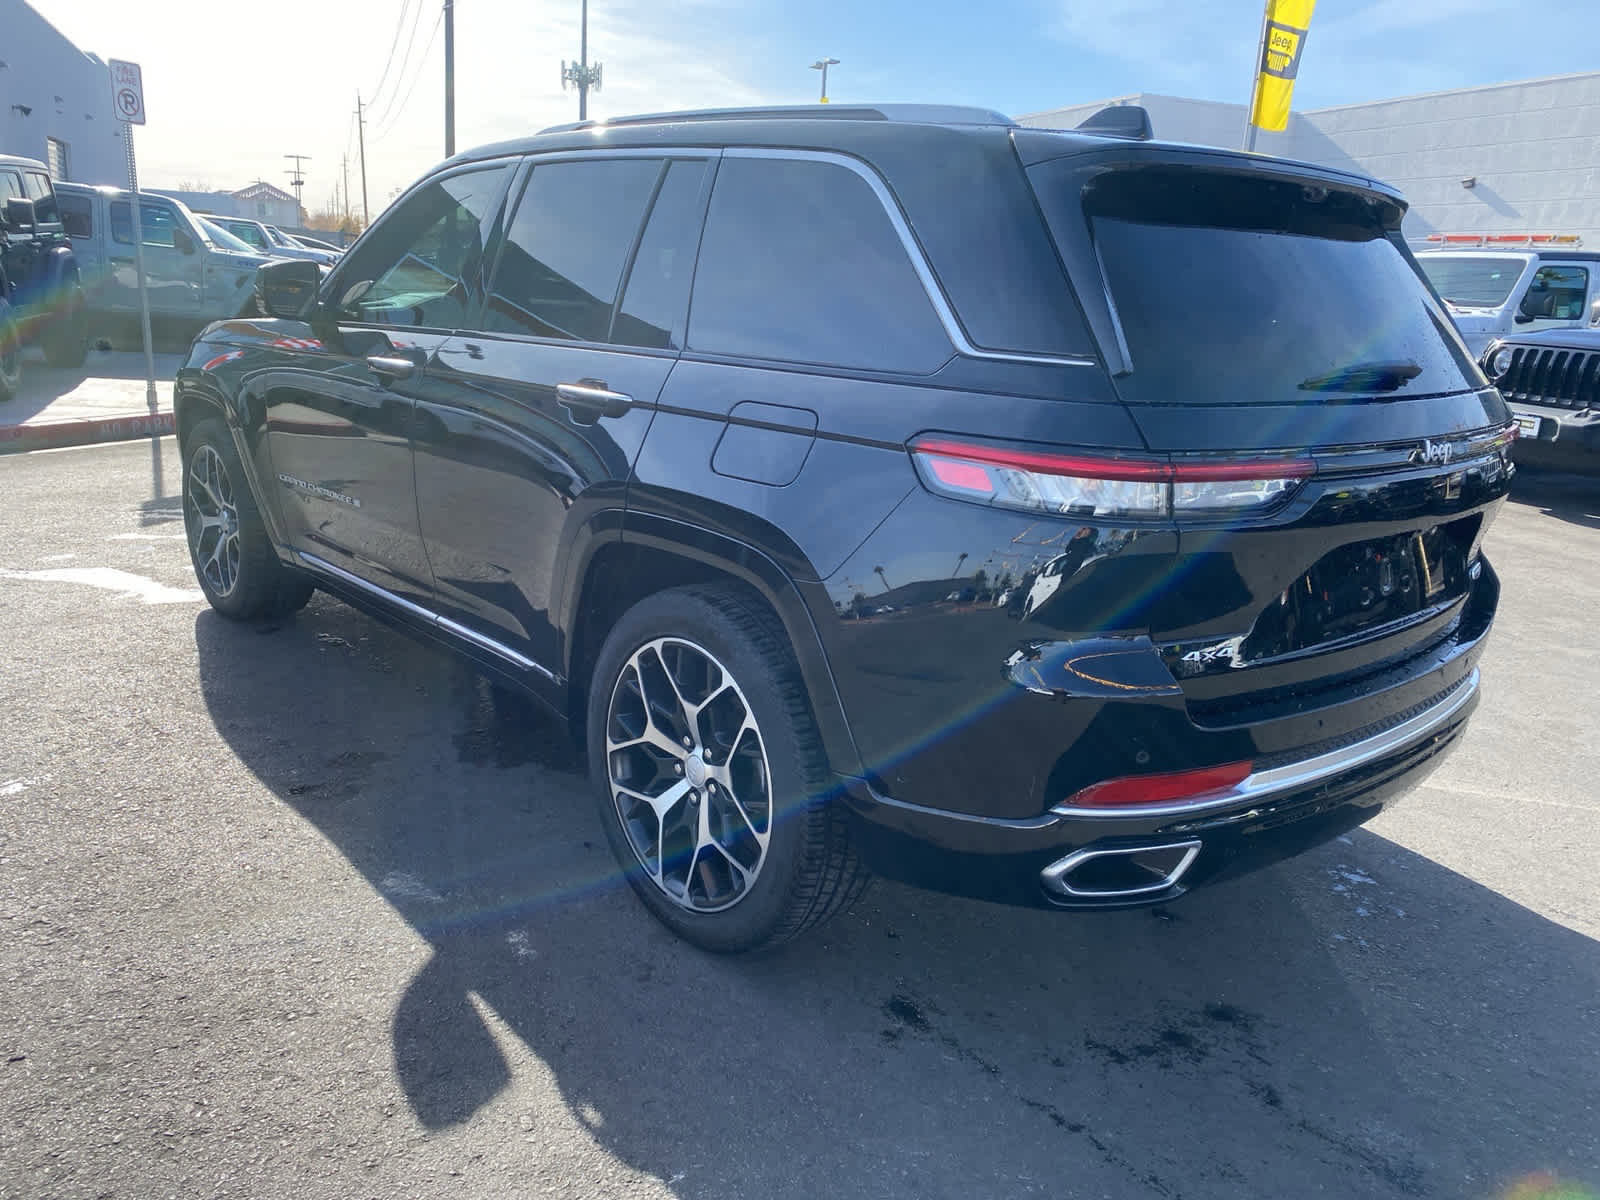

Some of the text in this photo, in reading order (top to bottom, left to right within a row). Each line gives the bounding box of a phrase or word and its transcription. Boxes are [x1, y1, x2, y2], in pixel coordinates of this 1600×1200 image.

[1271, 31, 1293, 52] Jeep
[116, 74, 138, 87] LANE
[1421, 438, 1453, 465] Jeep
